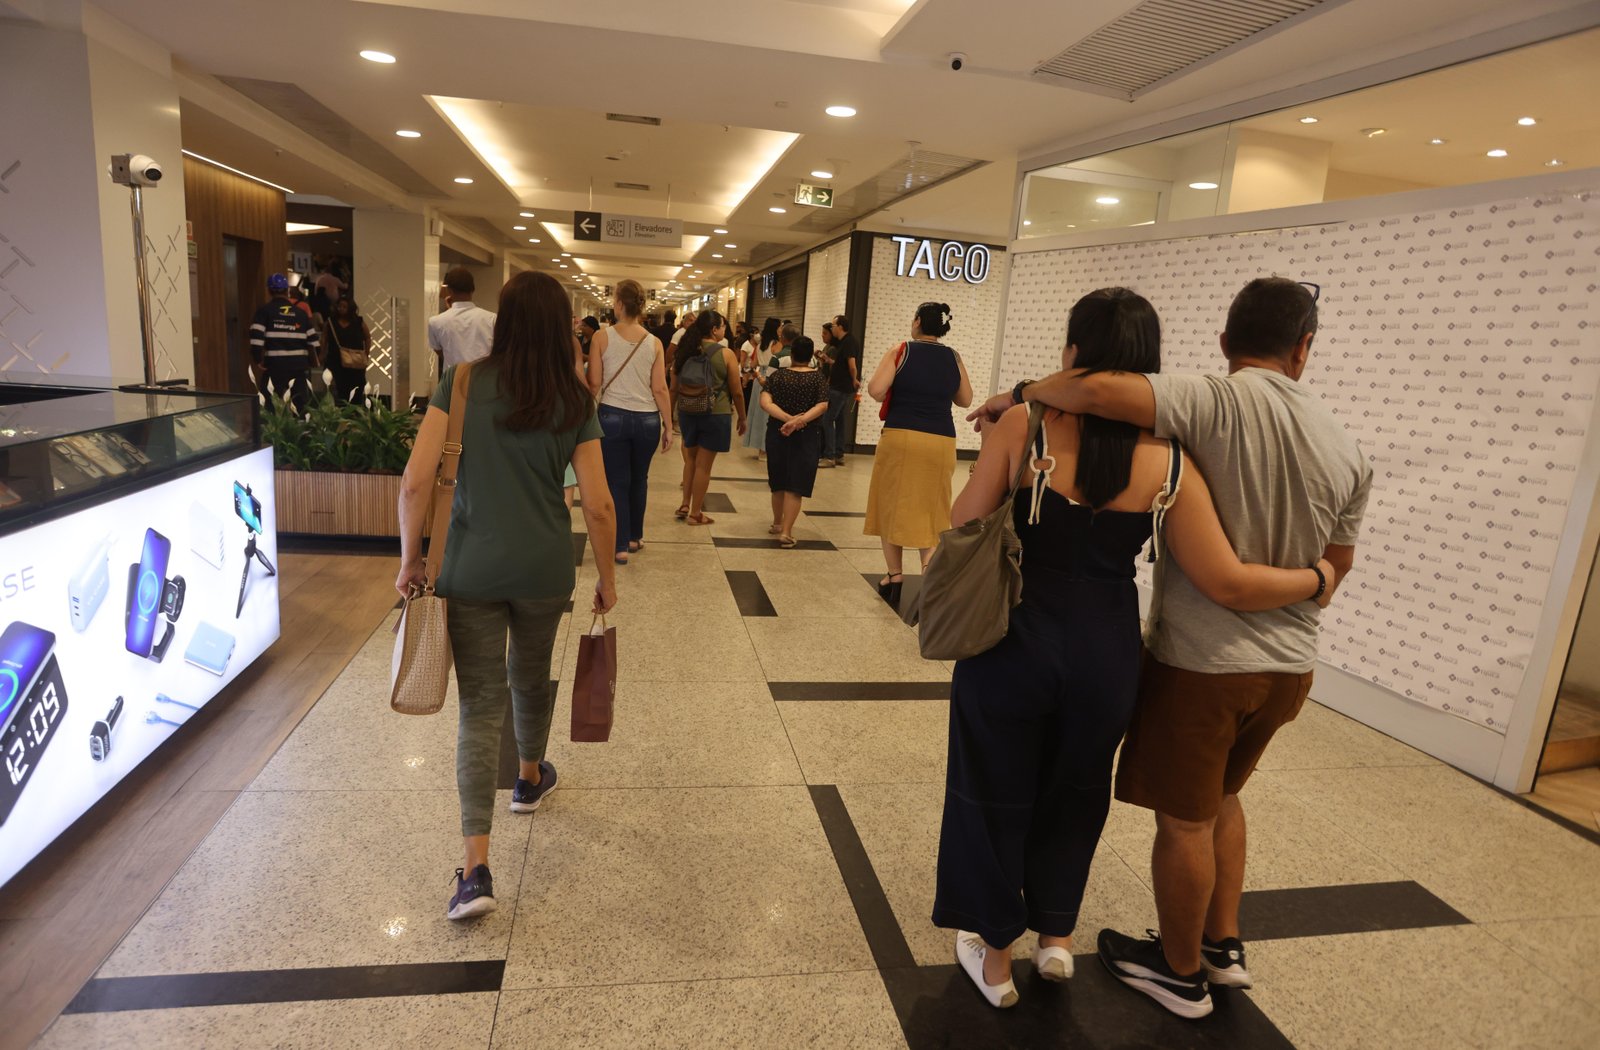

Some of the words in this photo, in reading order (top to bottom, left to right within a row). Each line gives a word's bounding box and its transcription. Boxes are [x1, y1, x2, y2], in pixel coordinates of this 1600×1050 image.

[634, 222, 673, 234] Elevadores
[892, 236, 990, 284] TACO
[0, 566, 36, 602] SE
[6, 682, 60, 785] 12:09
